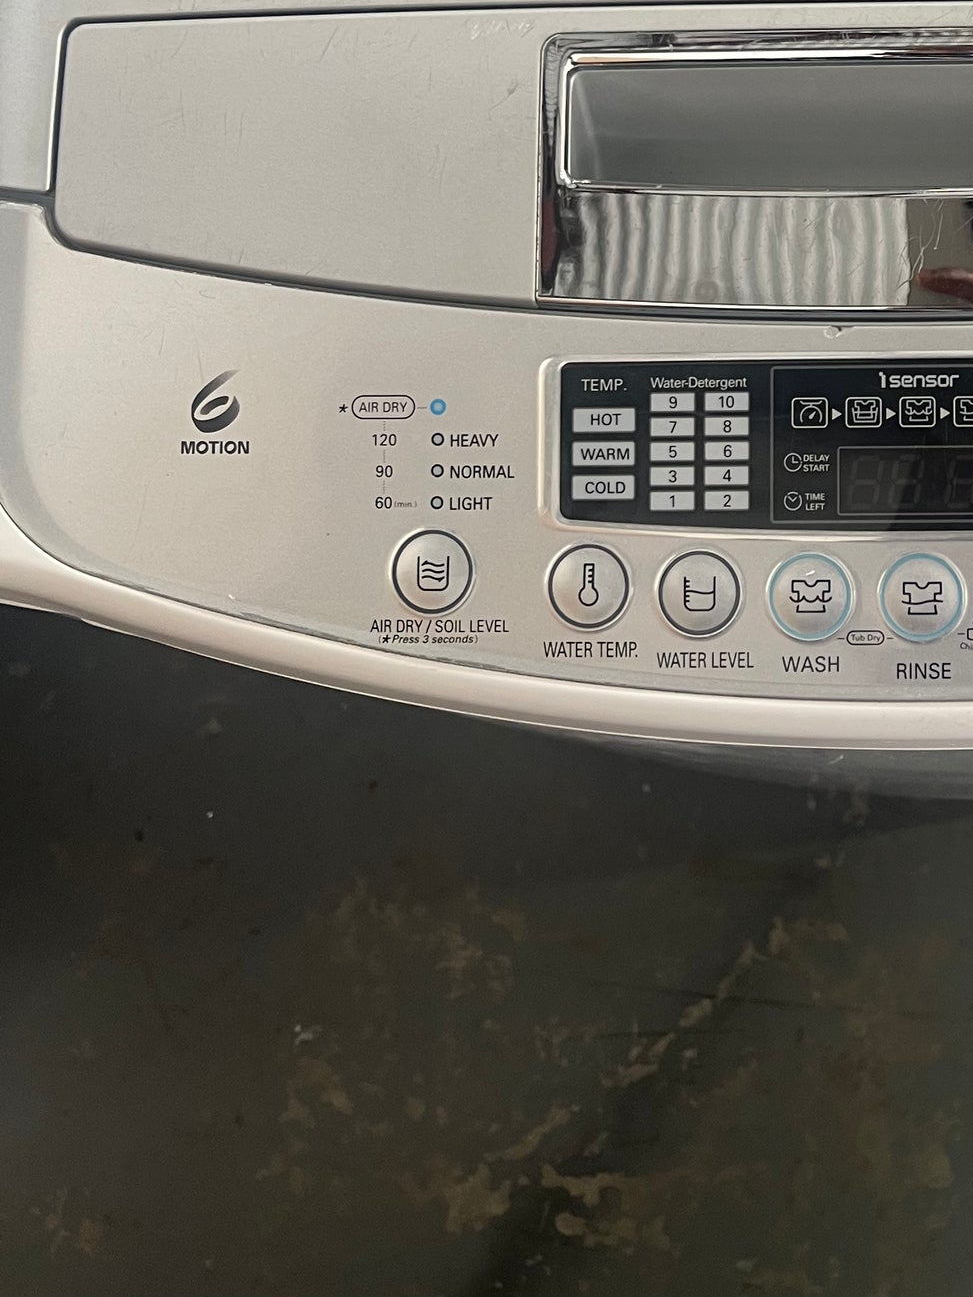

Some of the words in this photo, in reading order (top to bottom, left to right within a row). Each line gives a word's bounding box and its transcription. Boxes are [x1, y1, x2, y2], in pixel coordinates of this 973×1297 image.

[581, 379, 627, 391] TEMP.
[650, 377, 747, 390] Water-Detergent
[358, 401, 379, 413] AIR
[382, 401, 408, 413] DRY
[669, 396, 678, 408] 9
[718, 396, 735, 408] 10
[590, 414, 622, 426] HOT
[723, 420, 732, 433] 8
[668, 421, 677, 433] 7
[372, 434, 397, 447] 120
[450, 434, 499, 448] HEAVY
[180, 440, 250, 455] MOTION
[669, 446, 677, 458] 5
[723, 445, 732, 458] 6
[580, 448, 630, 461] WARM
[803, 454, 830, 462] DELAY
[375, 465, 393, 478] 90
[449, 465, 515, 479] NORMAL
[803, 464, 830, 472] START
[668, 470, 677, 483] 3
[722, 469, 732, 482] 4
[585, 482, 626, 494] COLD
[375, 496, 392, 510] 60
[669, 495, 675, 507] 1
[723, 495, 731, 507] 2
[805, 492, 826, 501] TIME
[449, 496, 493, 511] LIGHT
[805, 503, 825, 511] LEFT
[370, 620, 392, 632] AIR
[397, 619, 423, 632] DRY
[435, 619, 465, 633] SOIL
[470, 619, 509, 632] LEVEL
[423, 635, 429, 643] 3
[868, 634, 880, 643] Dry
[543, 641, 593, 658] WATER
[596, 642, 638, 658] TEMP.
[656, 652, 707, 668] WATER
[711, 652, 754, 669] LEVEL
[782, 656, 840, 673] WASH
[896, 662, 952, 680] RINSE
